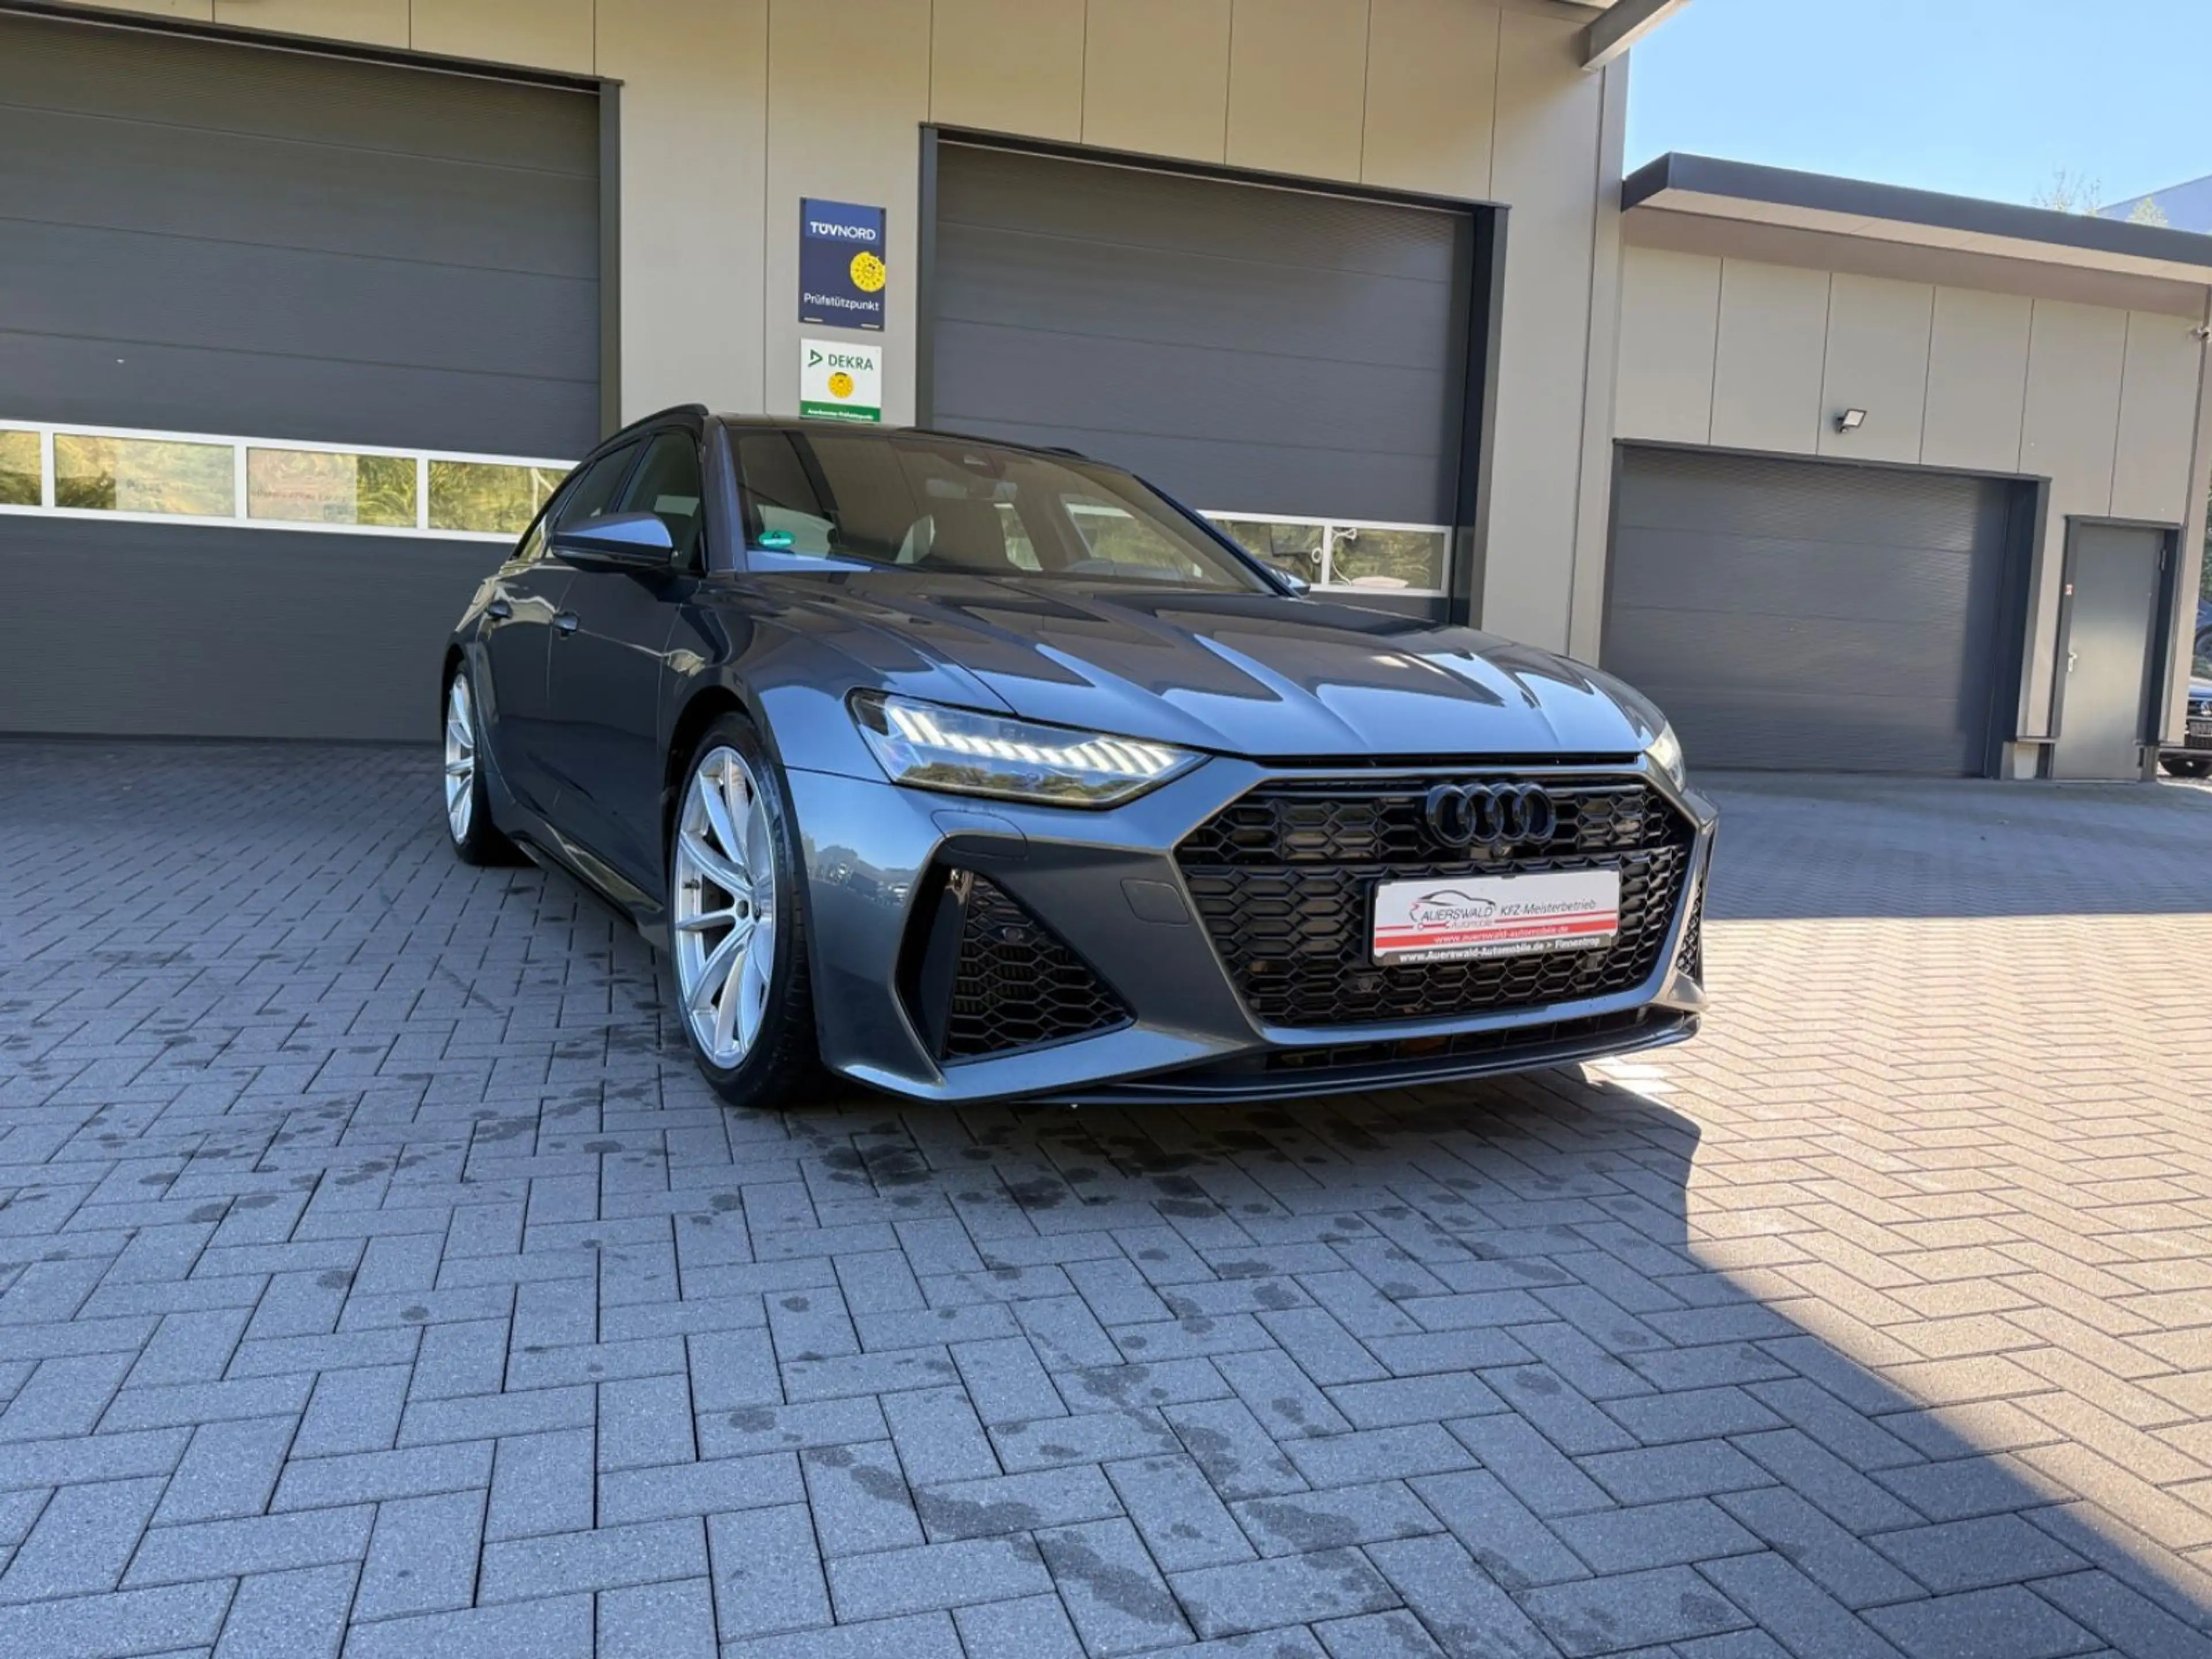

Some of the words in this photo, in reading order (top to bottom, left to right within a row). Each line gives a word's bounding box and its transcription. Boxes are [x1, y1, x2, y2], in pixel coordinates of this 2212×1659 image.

[804, 291, 880, 312] Prüfstützpunkt
[828, 353, 873, 371] DEKRA
[1421, 906, 1493, 922] AUERSWALD
[1500, 899, 1597, 917] KFZ-Meisterbetrieb
[1399, 942, 1544, 963] www.Auerswald-Automobile.de
[1555, 937, 1600, 949] Finnentrop
